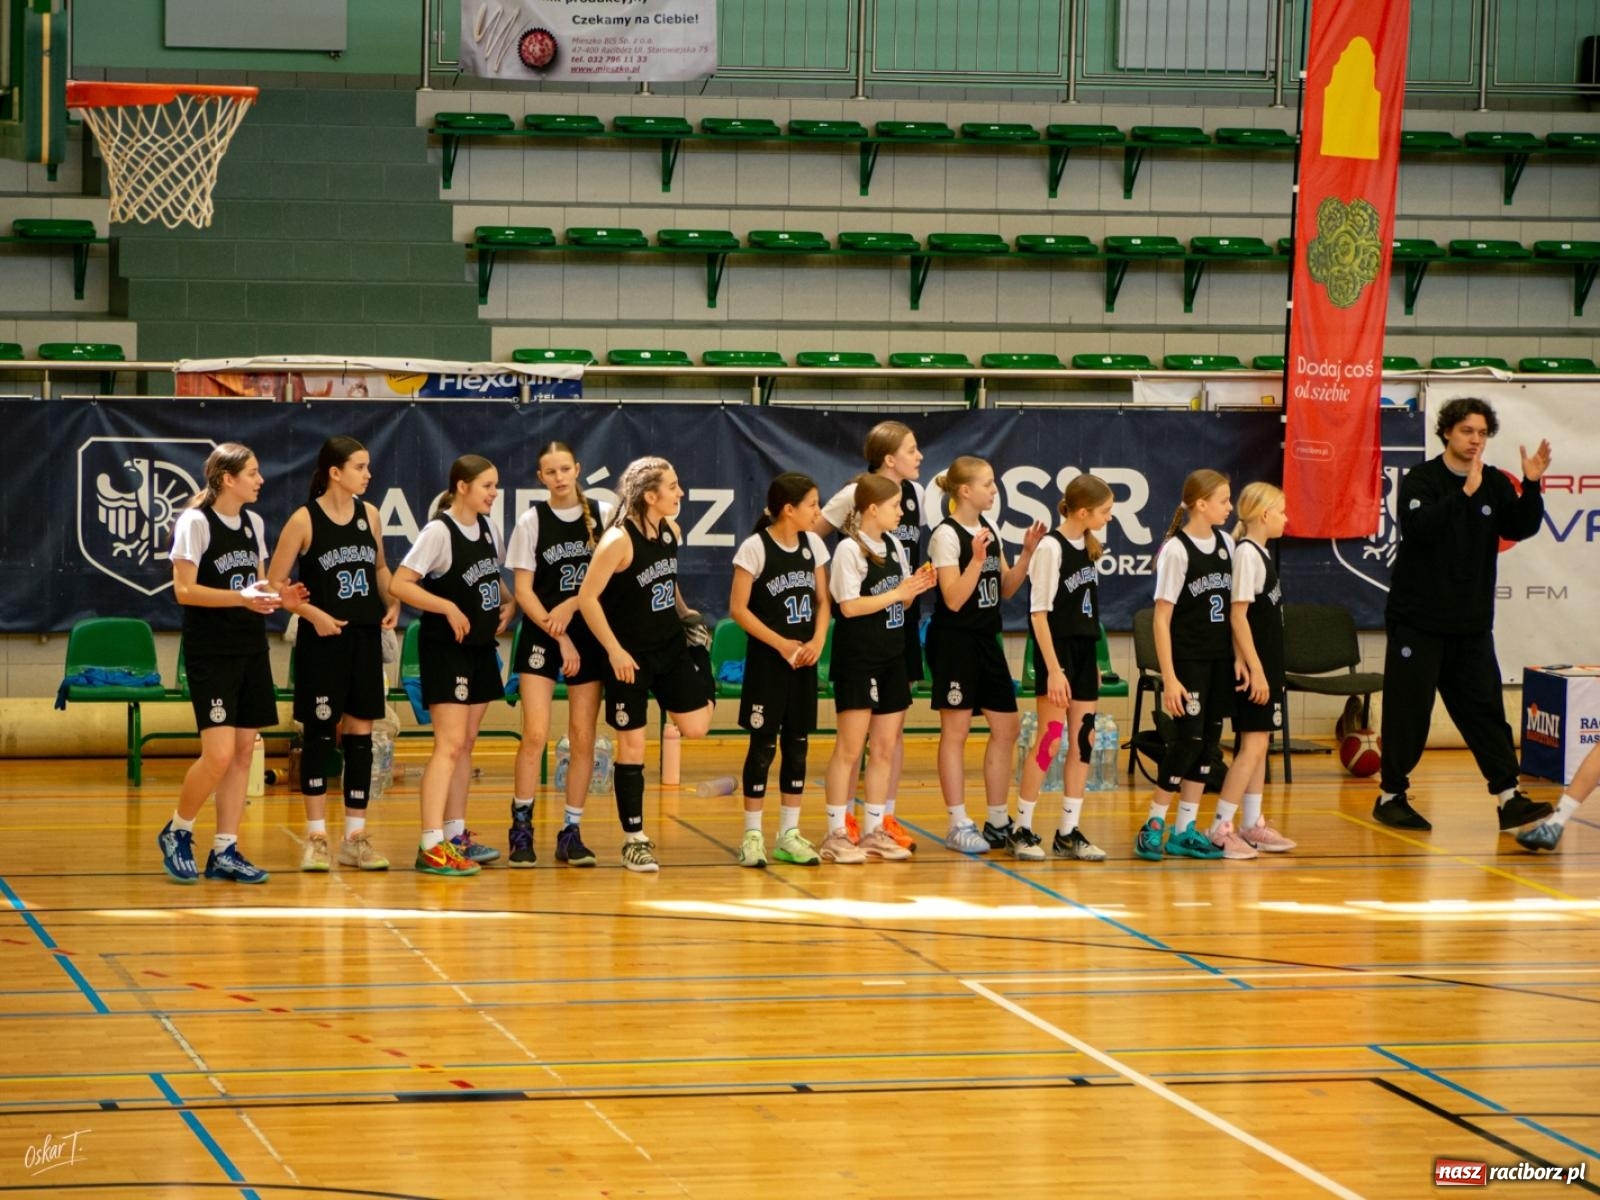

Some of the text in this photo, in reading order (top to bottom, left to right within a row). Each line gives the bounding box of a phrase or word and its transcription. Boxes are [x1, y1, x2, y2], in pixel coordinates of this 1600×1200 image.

[572, 13, 700, 26] Czekamy na Ciebie!
[1297, 355, 1374, 383] Dodaj coś
[1294, 380, 1351, 402] od siebie
[336, 568, 369, 600] 34
[559, 562, 588, 592] 24
[977, 576, 999, 608] 10
[478, 579, 500, 612] 30
[651, 579, 676, 613] 22
[1082, 587, 1094, 618] 4
[1526, 585, 1569, 600] FM
[784, 594, 813, 624] 14
[1209, 593, 1225, 623] 2
[1526, 706, 1560, 739] MINI
[1580, 717, 1600, 730] RA
